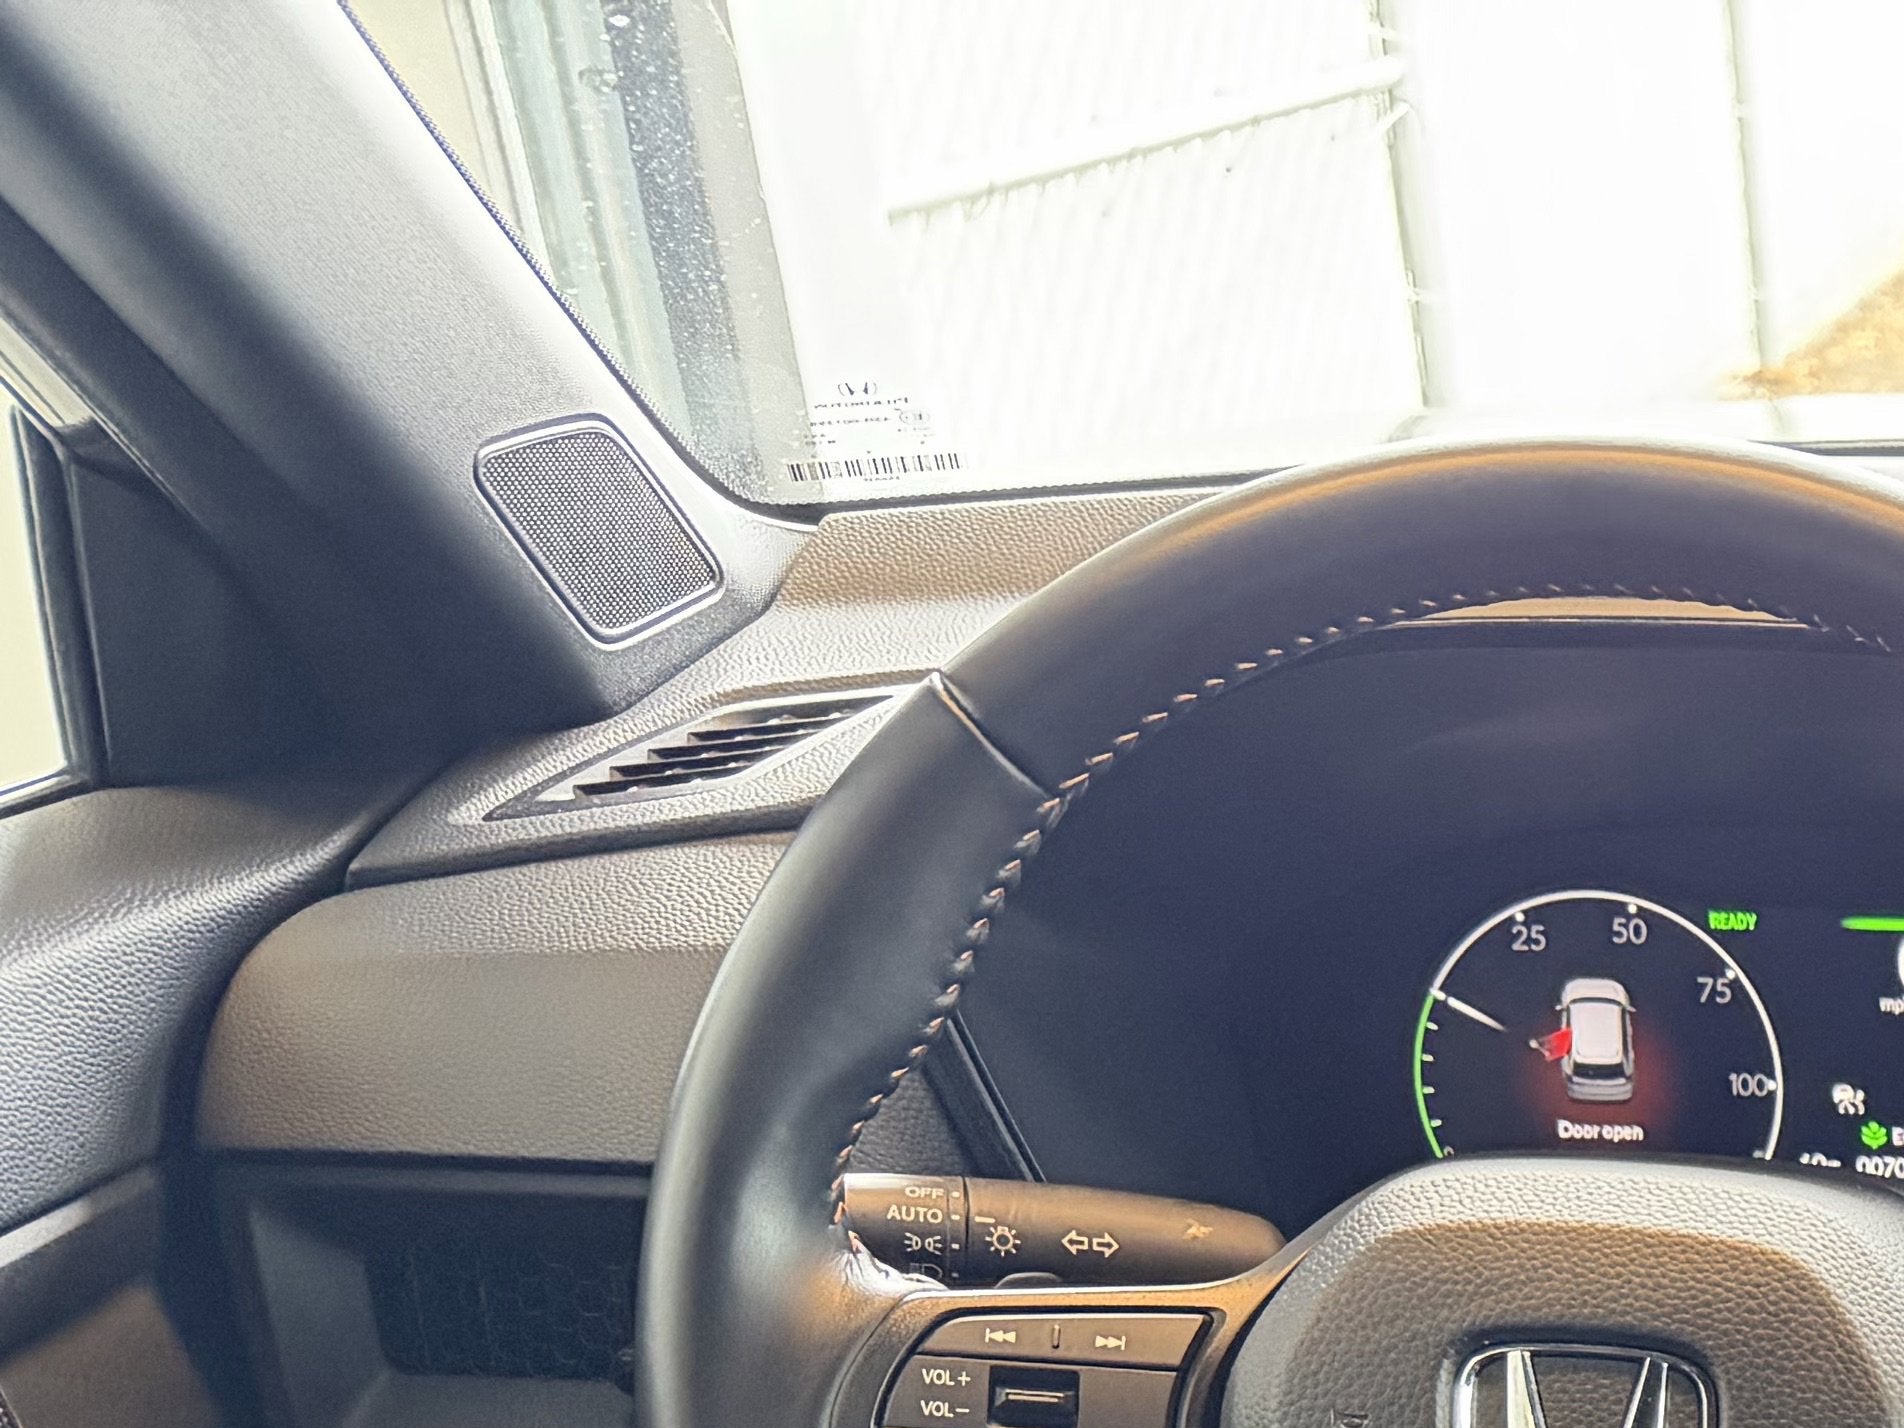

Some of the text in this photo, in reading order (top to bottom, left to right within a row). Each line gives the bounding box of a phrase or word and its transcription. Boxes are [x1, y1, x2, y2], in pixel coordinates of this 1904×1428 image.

[1612, 918, 1647, 944] 50
[1708, 910, 1757, 931] READY
[1510, 925, 1546, 951] 25
[1697, 977, 1732, 1004] 75
[1728, 1073, 1769, 1097] 100
[1557, 1119, 1644, 1143] Door open
[905, 1186, 945, 1200] OFF
[887, 1204, 943, 1223] AUTO
